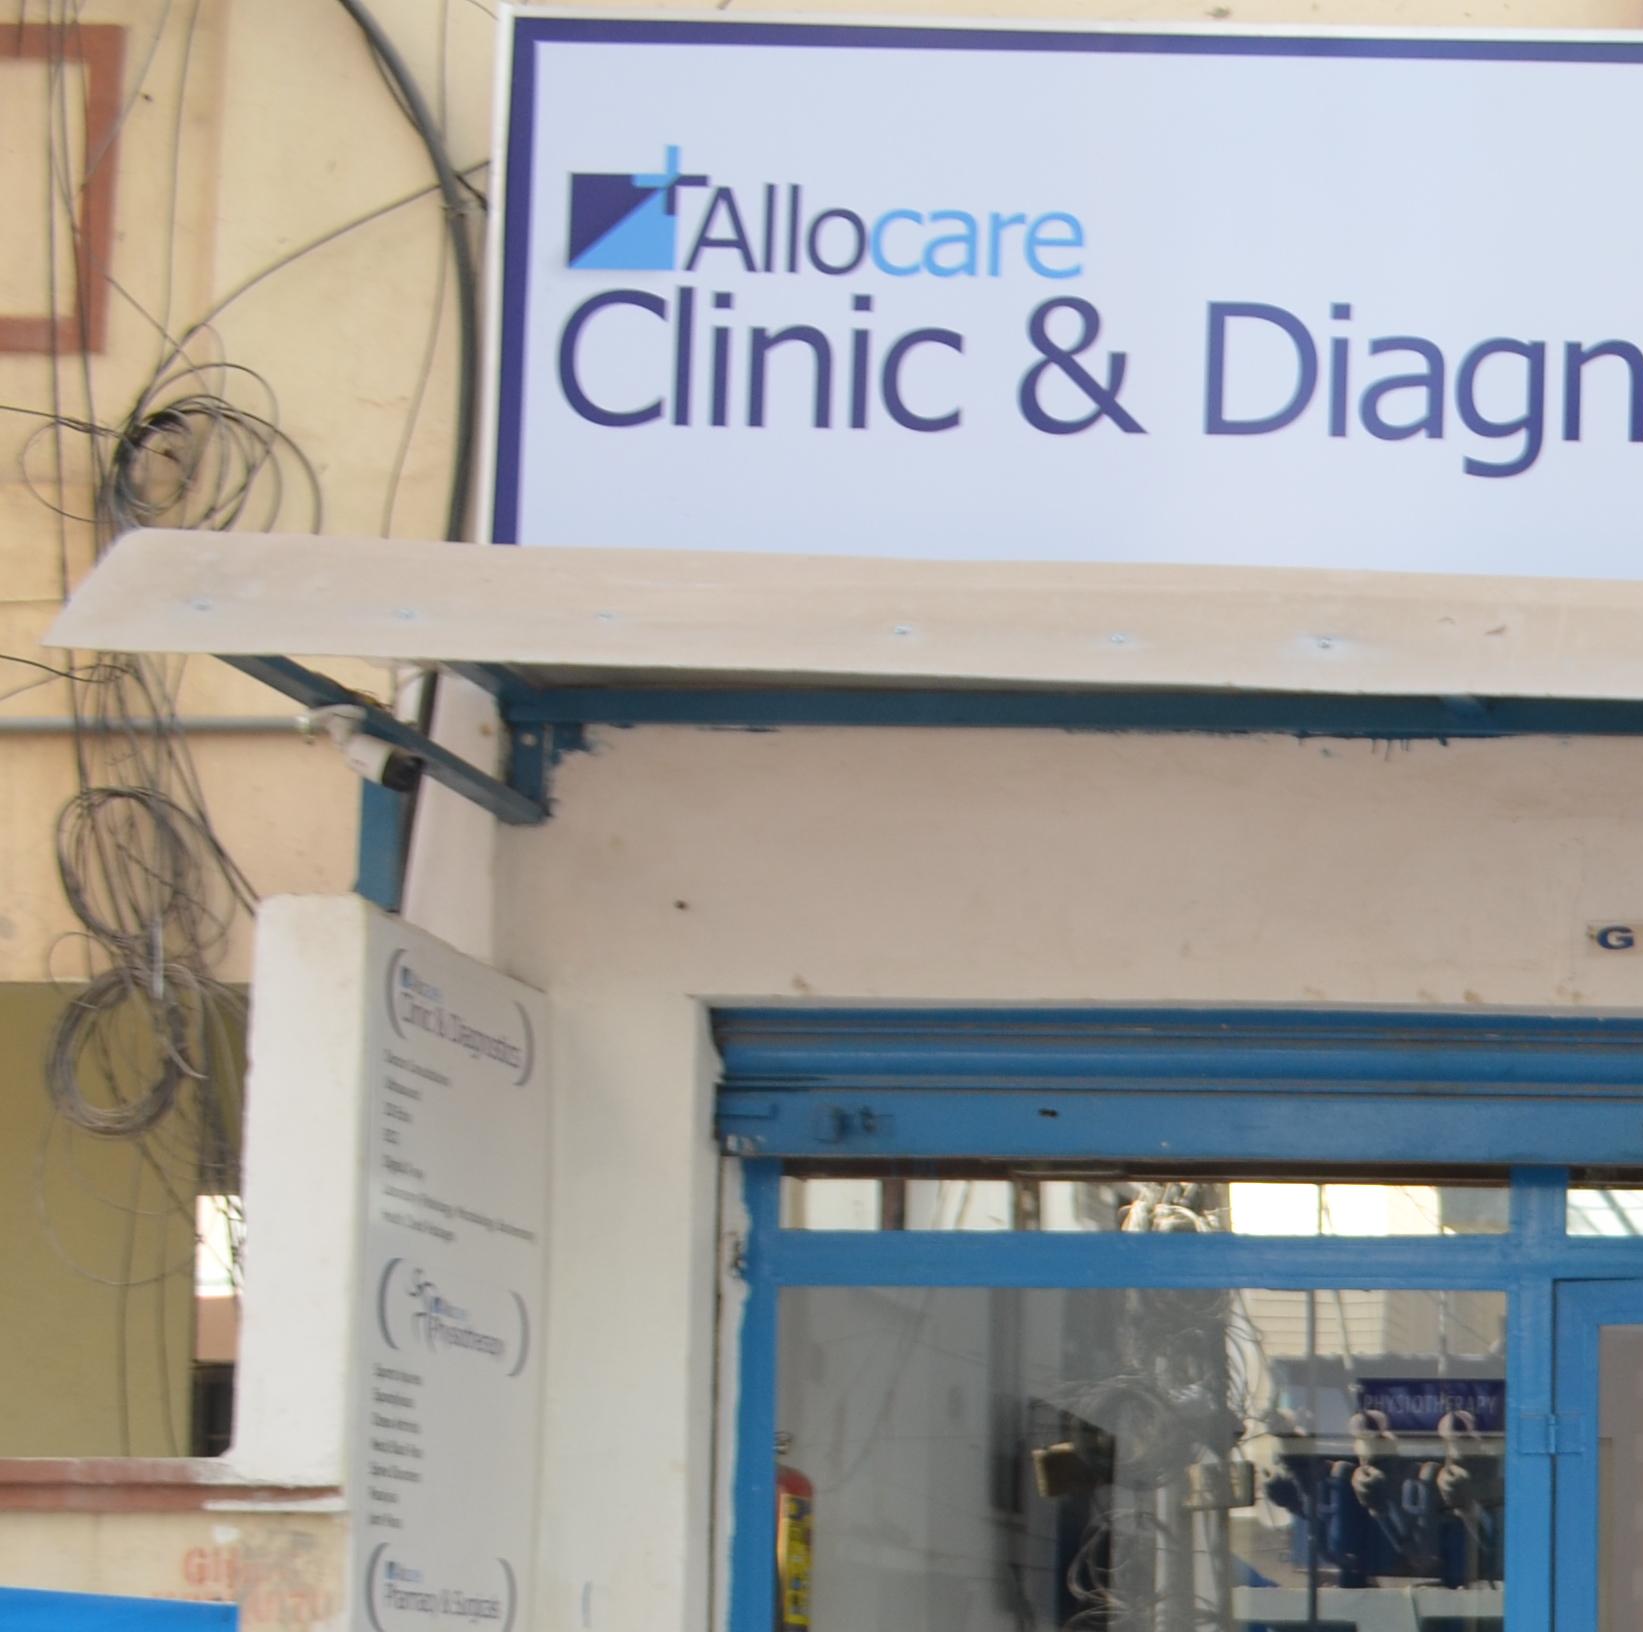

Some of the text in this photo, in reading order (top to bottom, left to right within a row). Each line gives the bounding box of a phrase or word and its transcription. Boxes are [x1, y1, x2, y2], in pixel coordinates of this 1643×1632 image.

[682, 183, 1084, 281] Allocare
[555, 288, 963, 437] Clinic
[1016, 295, 1148, 438] &
